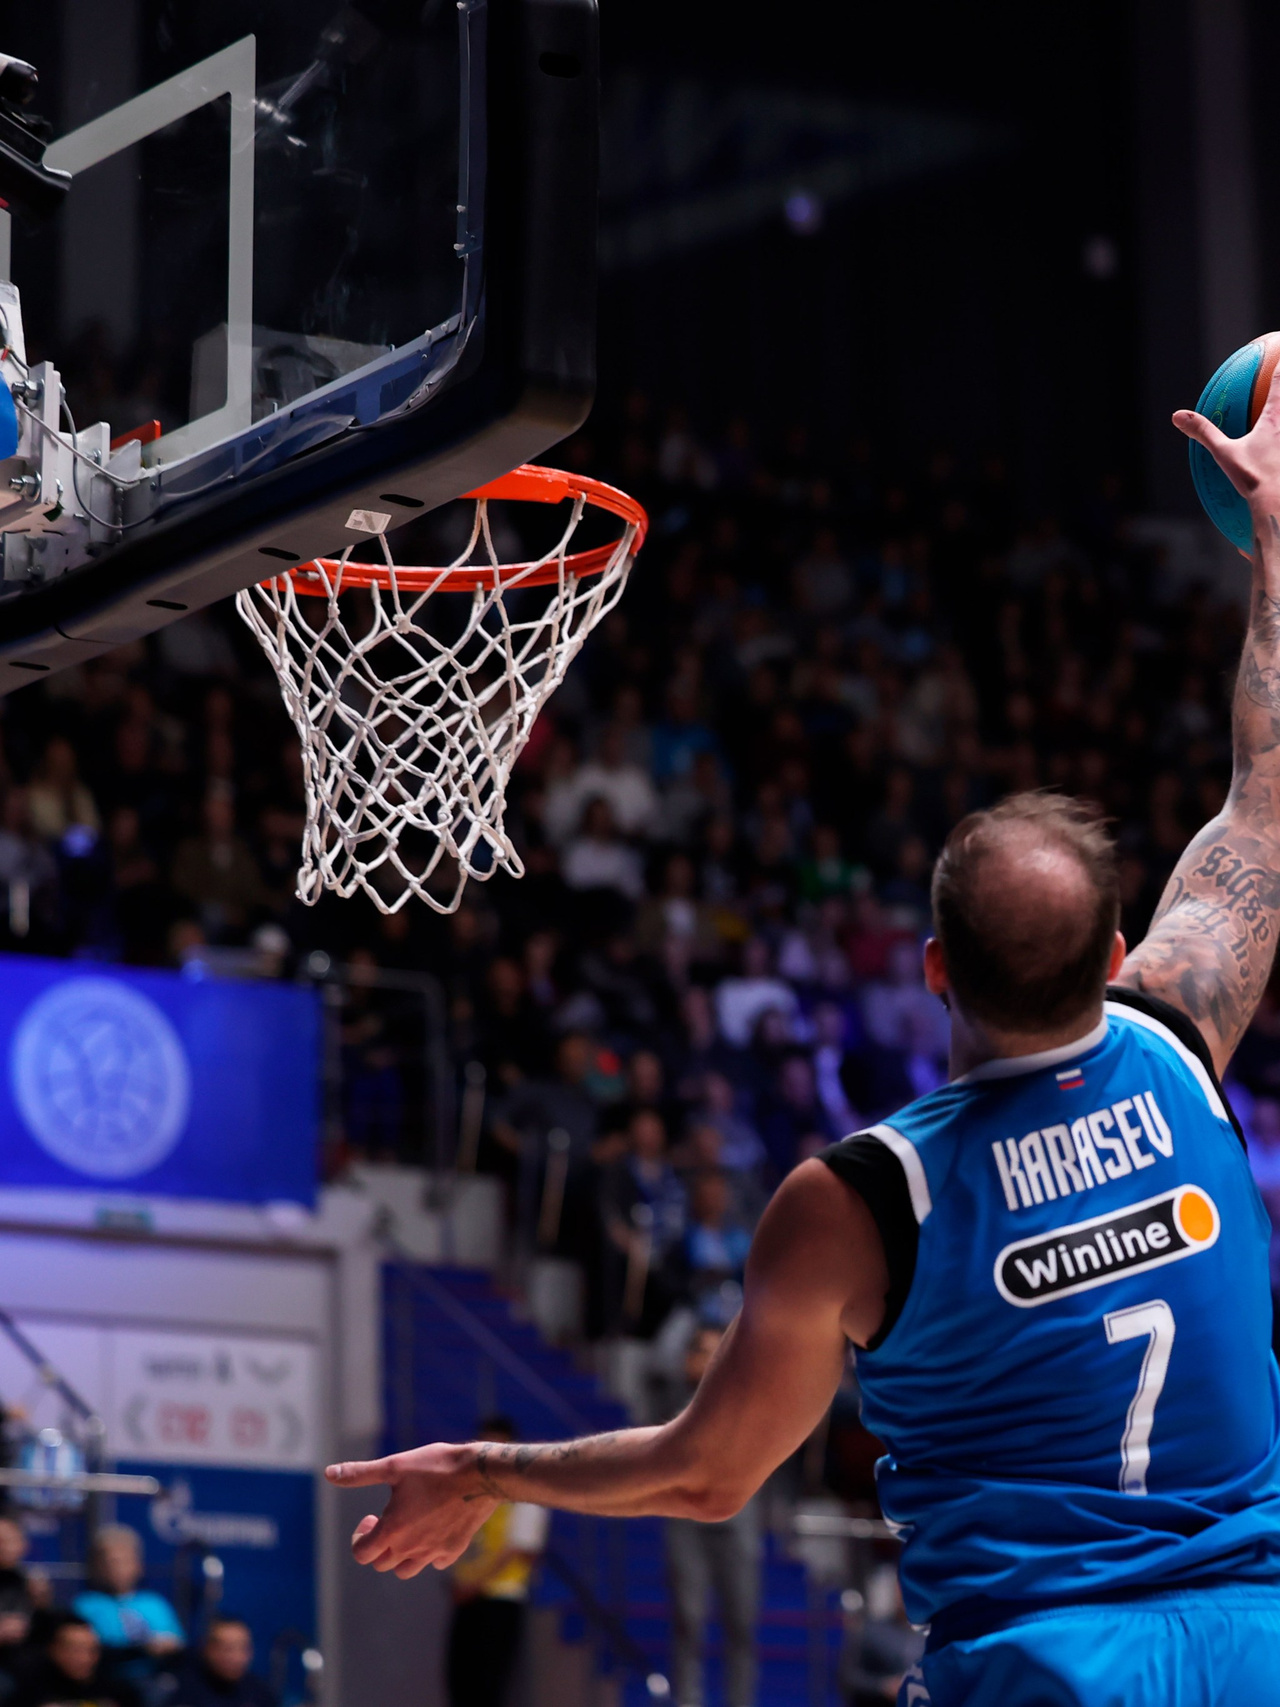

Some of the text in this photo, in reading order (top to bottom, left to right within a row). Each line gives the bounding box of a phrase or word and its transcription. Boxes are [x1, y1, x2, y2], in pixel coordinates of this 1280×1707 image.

[991, 1090, 1174, 1212] KARASEV
[1014, 1221, 1172, 1289] Winline
[1103, 1299, 1176, 1497] 7
